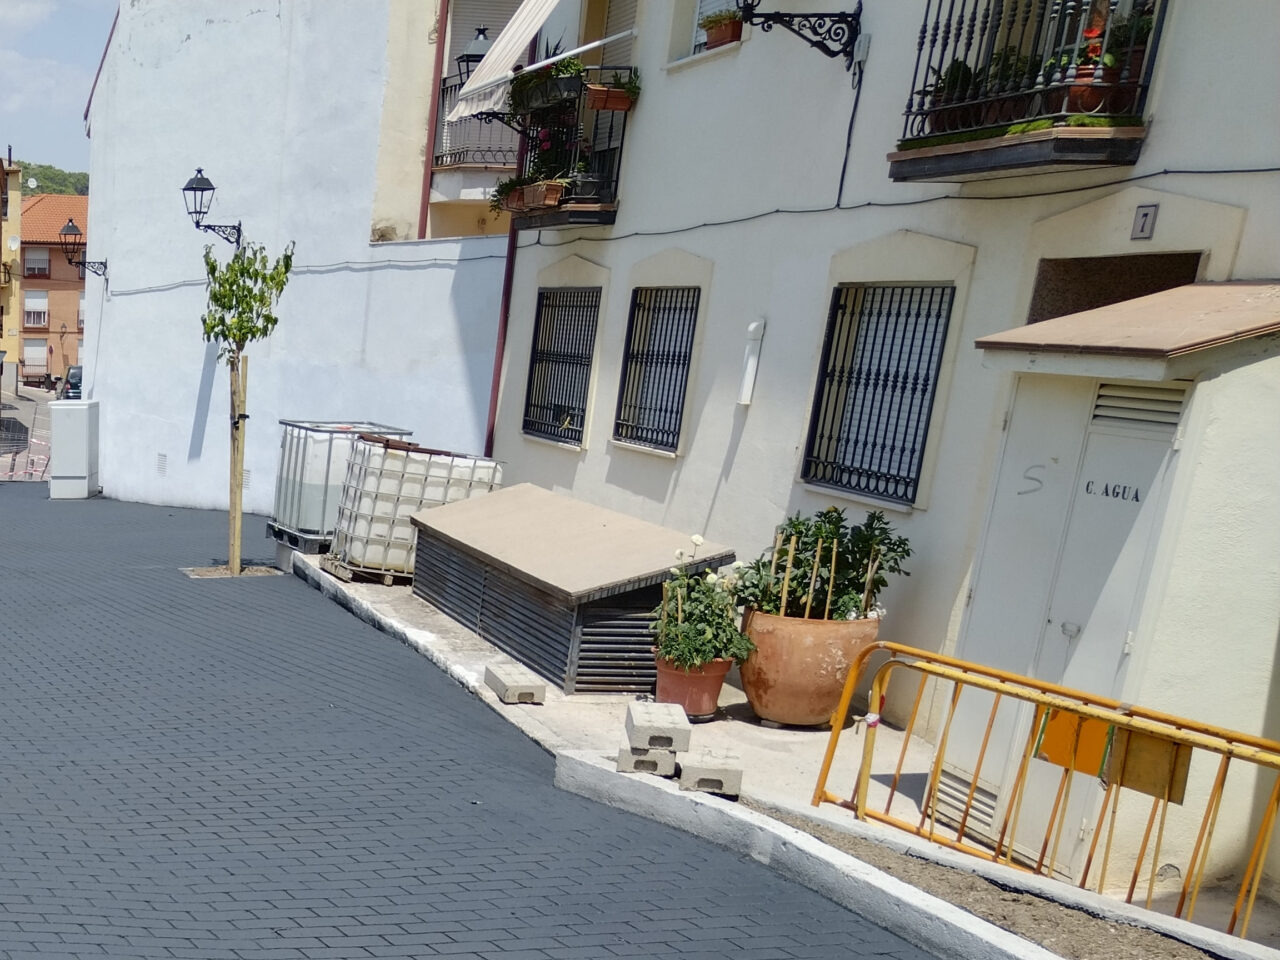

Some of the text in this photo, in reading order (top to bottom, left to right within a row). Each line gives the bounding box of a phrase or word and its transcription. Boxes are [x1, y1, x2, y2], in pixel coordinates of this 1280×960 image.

[1139, 212, 1149, 233] 7
[1085, 480, 1141, 503] C. AGUA
